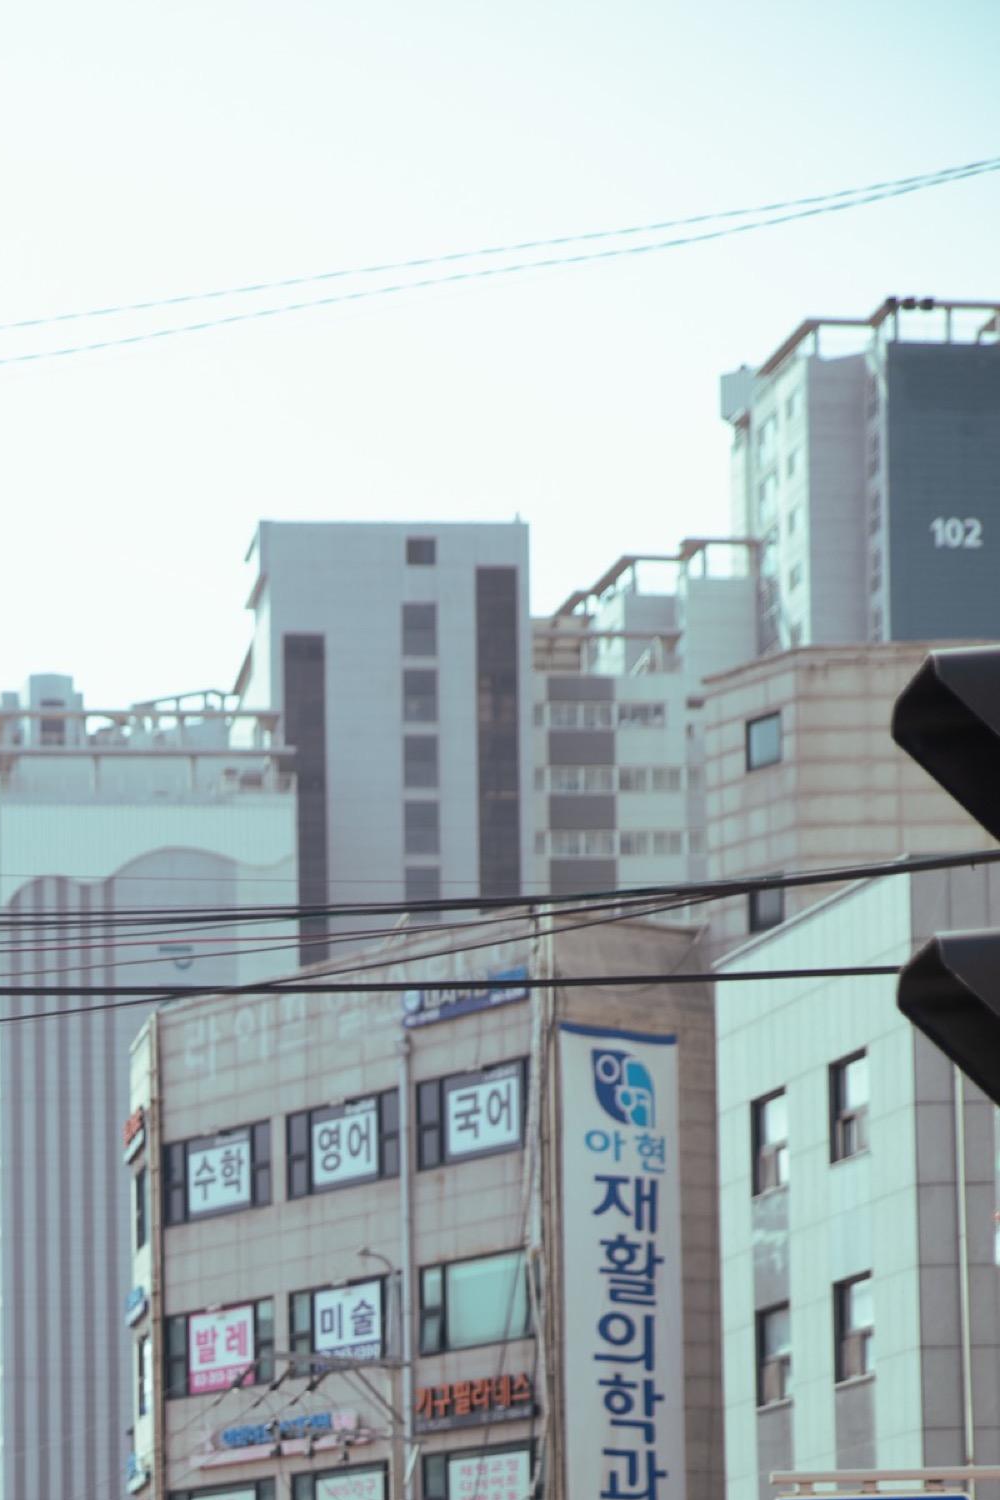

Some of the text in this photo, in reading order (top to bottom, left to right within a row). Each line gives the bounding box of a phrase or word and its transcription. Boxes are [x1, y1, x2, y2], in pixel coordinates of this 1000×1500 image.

[929, 516, 982, 549] 102
[454, 1083, 513, 1140] 국어
[318, 1117, 372, 1173] 영어
[584, 1129, 666, 1174] 아현
[193, 1148, 244, 1200] 수학
[320, 1299, 376, 1340] 미술
[195, 1323, 249, 1363] 발레
